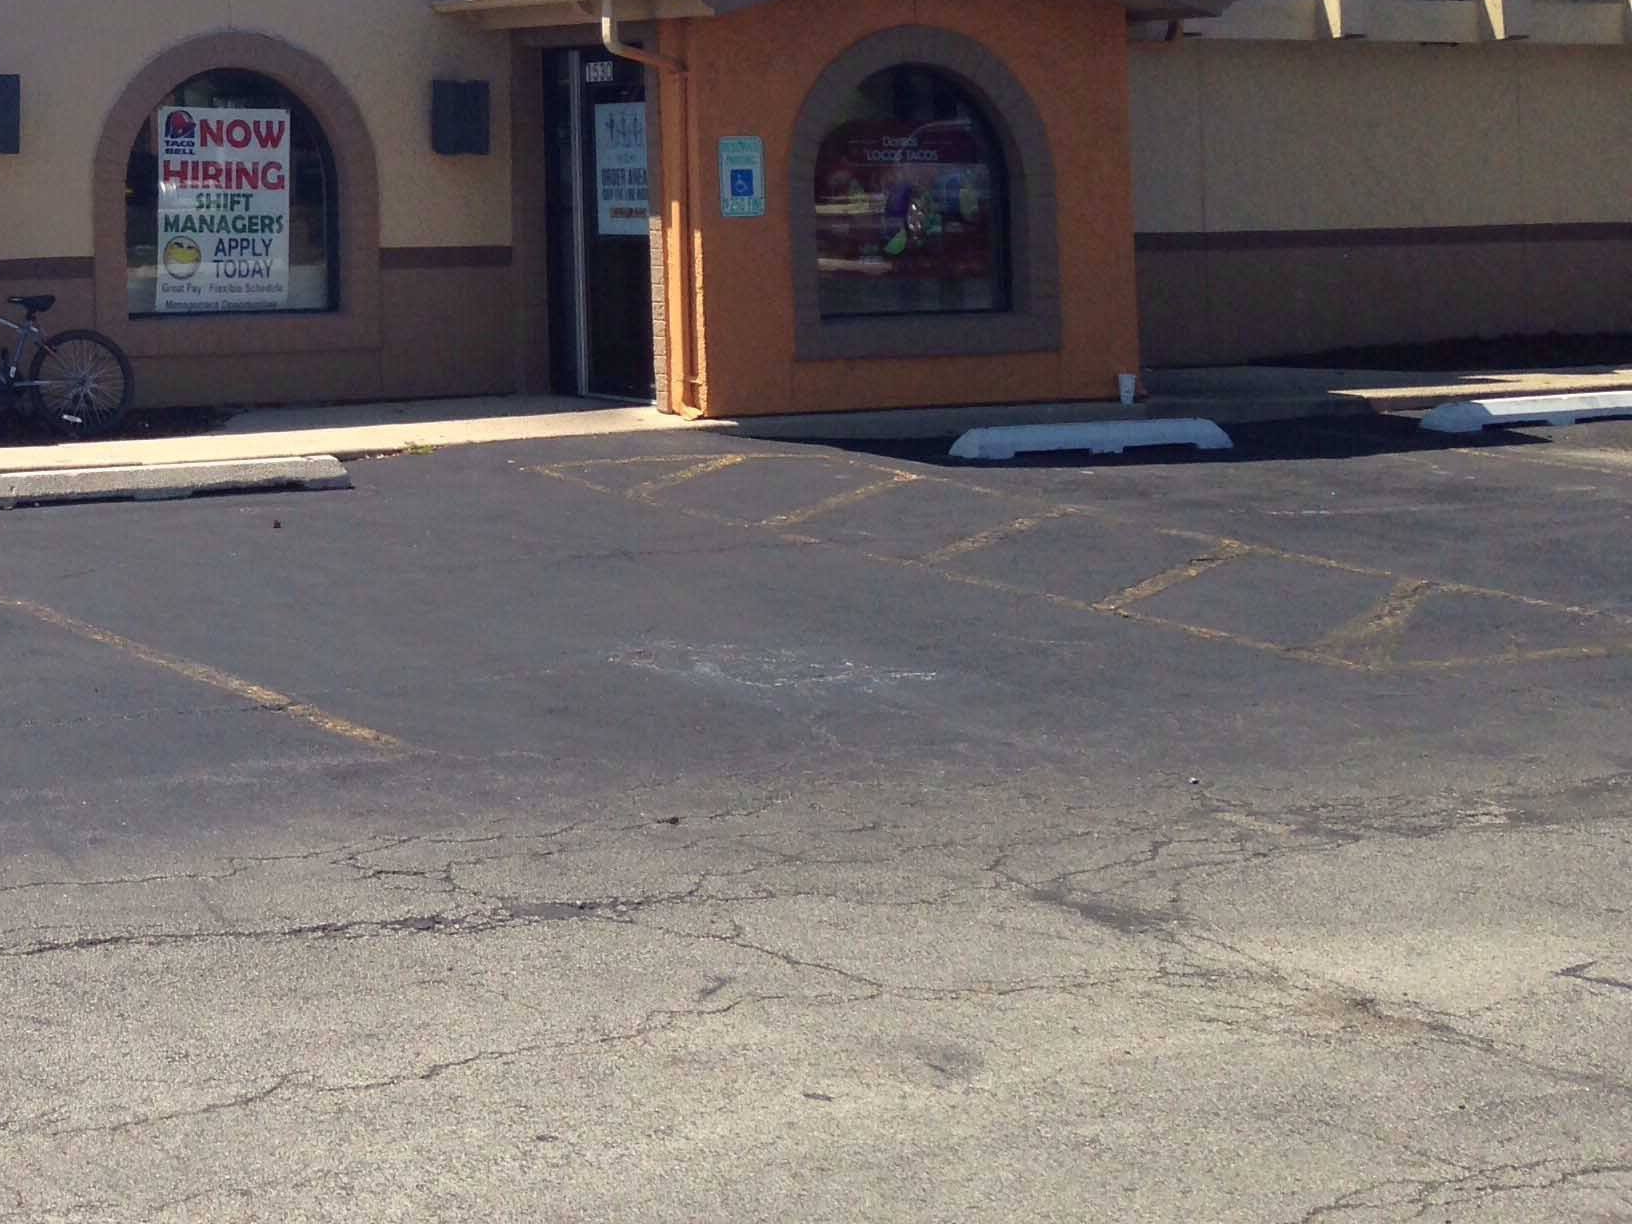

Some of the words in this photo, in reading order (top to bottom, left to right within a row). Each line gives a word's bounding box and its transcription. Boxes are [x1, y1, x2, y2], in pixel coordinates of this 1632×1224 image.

[200, 119, 285, 149] NOW
[163, 160, 285, 191] HIRING
[196, 193, 253, 211] SHIFT
[163, 214, 283, 234] MANAGERS
[214, 238, 273, 257] APPLY
[213, 260, 273, 279] TODAY
